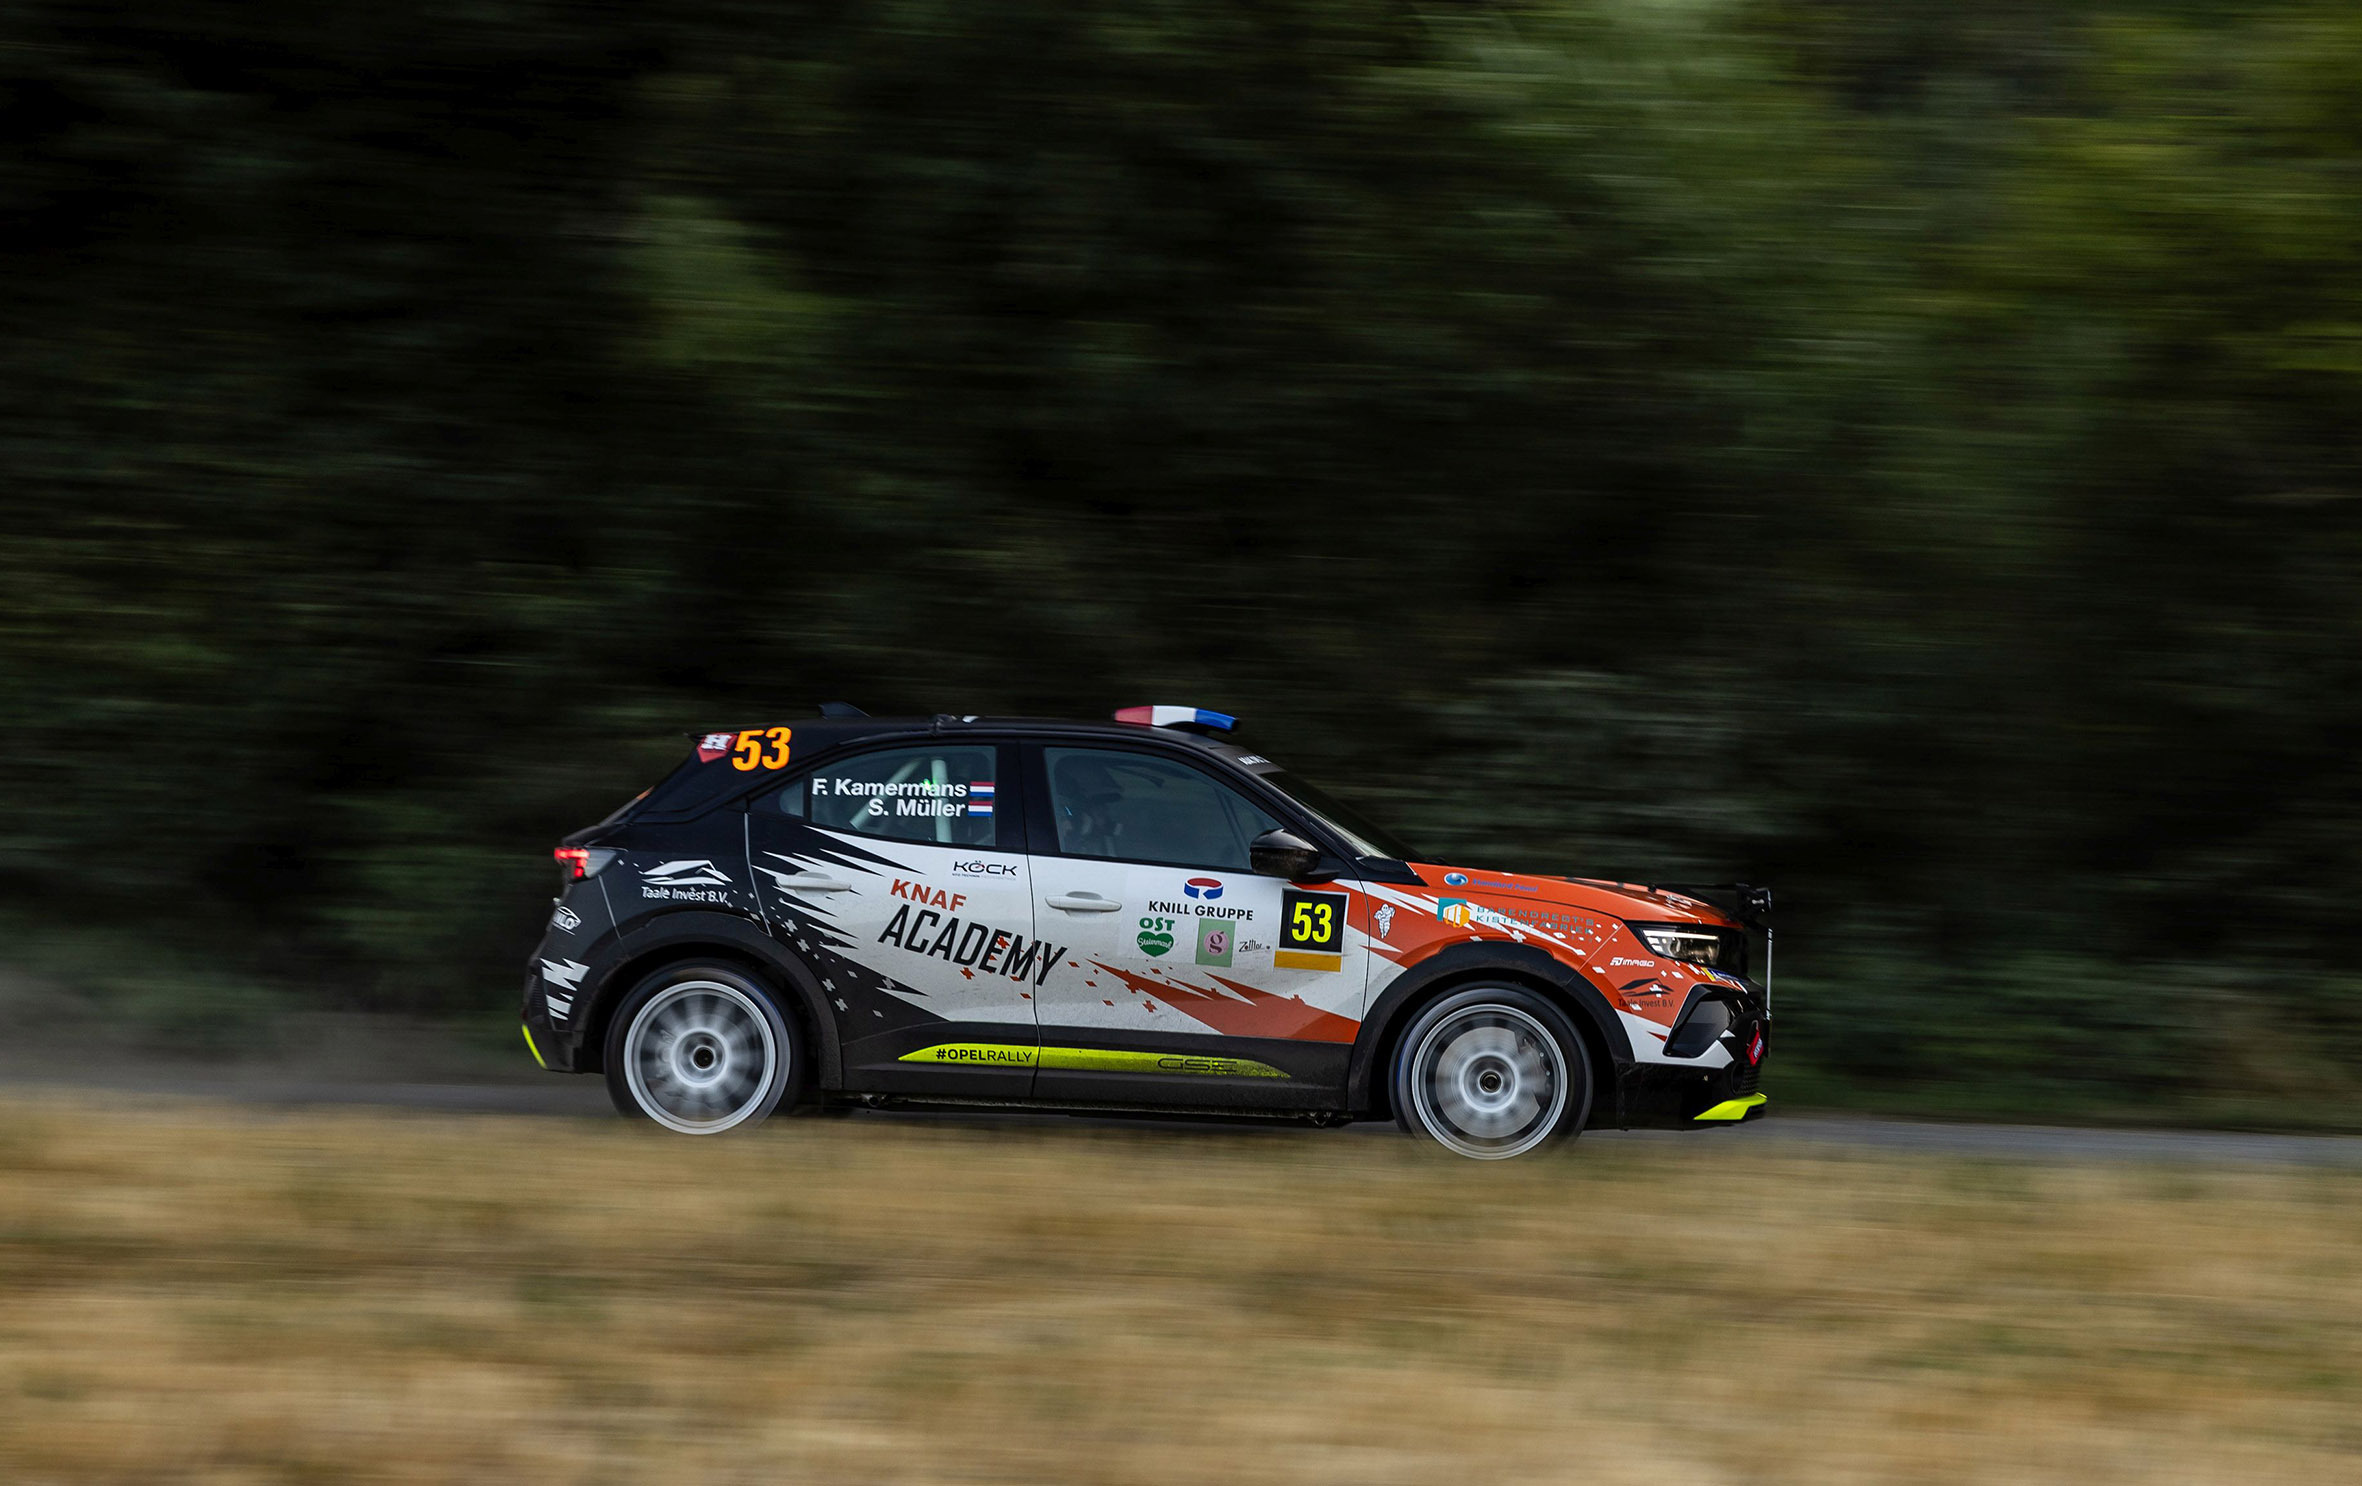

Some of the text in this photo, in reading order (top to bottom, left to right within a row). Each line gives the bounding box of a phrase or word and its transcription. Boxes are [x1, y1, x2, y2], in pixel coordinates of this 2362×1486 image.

[732, 727, 792, 771] 53
[812, 778, 967, 797] F. Kamermans
[868, 798, 966, 817] S. Müller
[953, 860, 1018, 876] KÖCK
[641, 886, 670, 899] Taale
[672, 888, 706, 901] Invest
[890, 878, 967, 912] KNAF
[1148, 901, 1254, 921] KNILL GRUPPE
[1139, 917, 1175, 932] OST
[1291, 901, 1333, 943] 53
[877, 904, 1068, 986] ACADEMY
[936, 1049, 1032, 1062] #OPELRALLY
